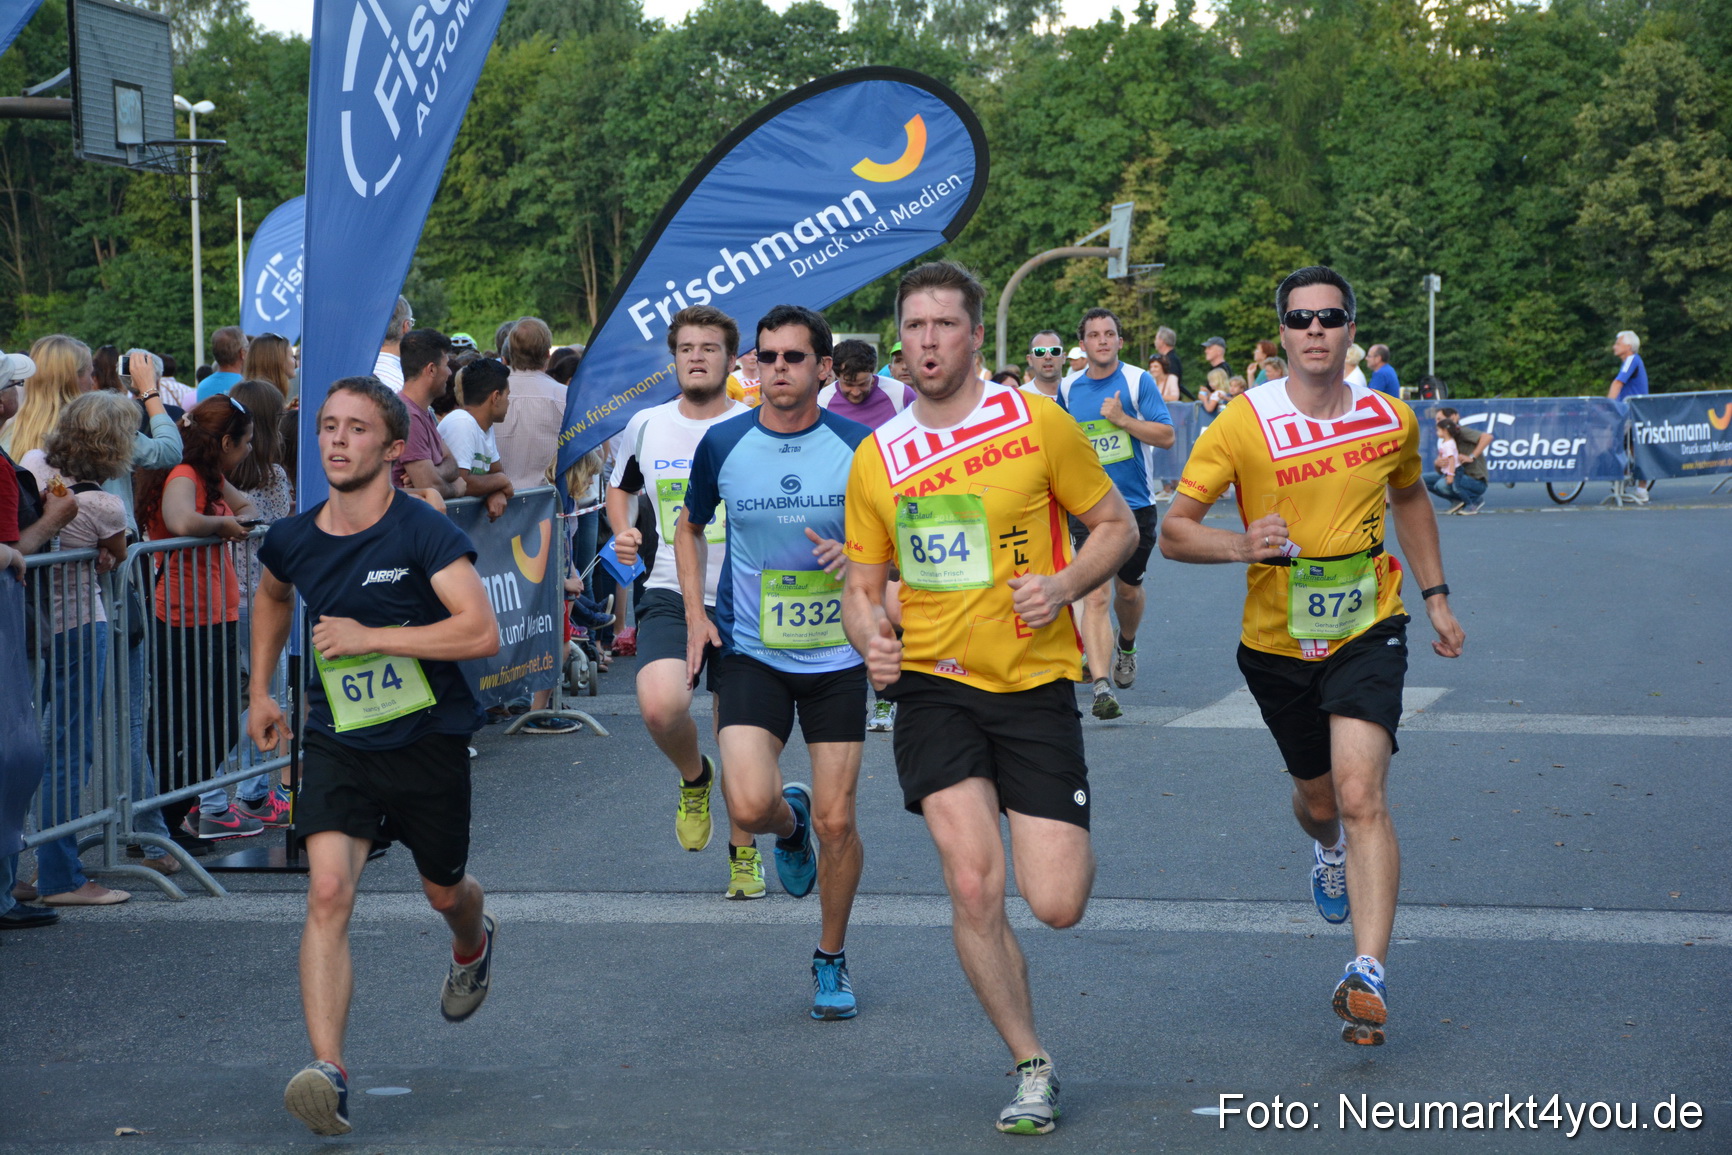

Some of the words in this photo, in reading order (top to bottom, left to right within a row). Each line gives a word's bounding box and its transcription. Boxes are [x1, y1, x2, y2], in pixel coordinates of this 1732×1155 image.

[789, 237, 849, 278] Druck
[851, 217, 890, 244] und
[890, 174, 963, 226] Medien
[627, 189, 878, 341] Frischmann
[1090, 435, 1121, 452] 792
[1483, 433, 1587, 457] scher
[1635, 420, 1711, 444] Frischmann
[893, 467, 957, 507] MAX
[963, 436, 1040, 477] BÖGL
[1275, 456, 1336, 487] MAX
[1343, 440, 1401, 469] BÖGL
[1486, 458, 1576, 470] UTOMOBILE
[736, 495, 845, 511] SCHABMÜLLER
[777, 515, 806, 524] TEAM
[910, 532, 970, 564] 854
[771, 599, 841, 627] 1332
[1308, 588, 1363, 618] 873
[505, 615, 525, 645] und
[341, 662, 403, 702] 674
